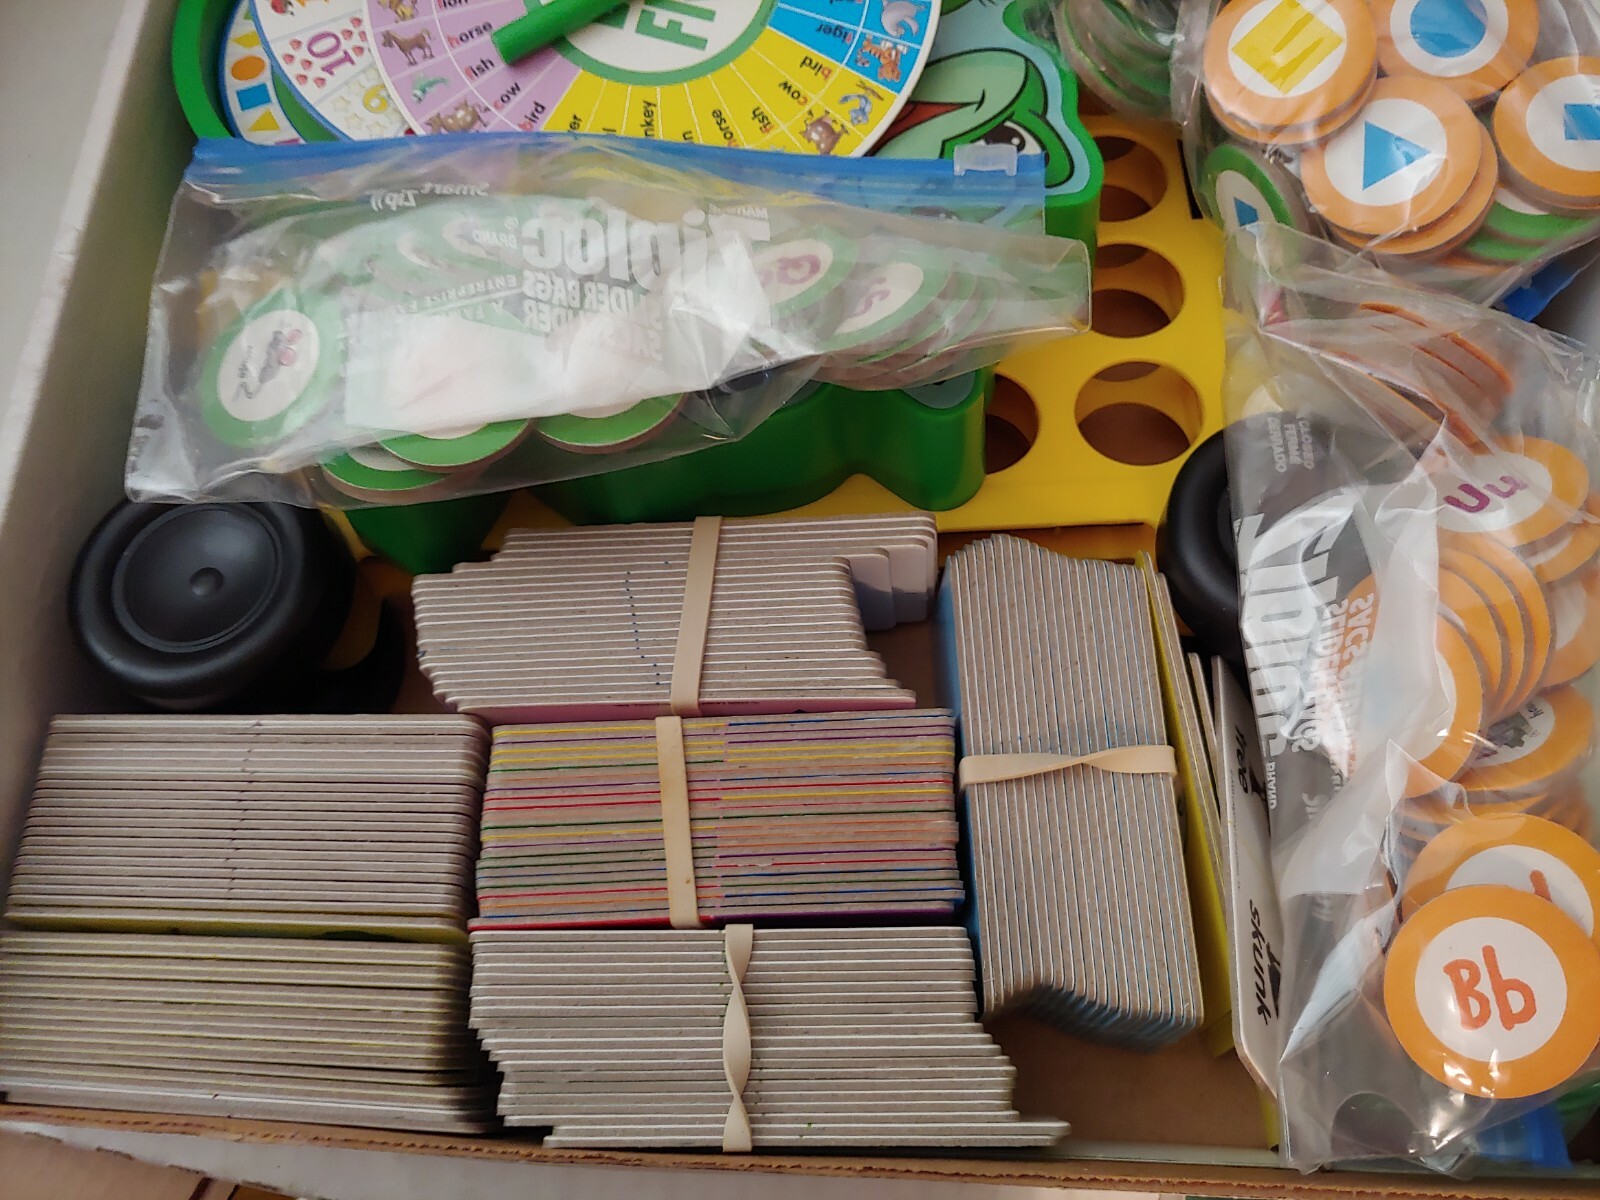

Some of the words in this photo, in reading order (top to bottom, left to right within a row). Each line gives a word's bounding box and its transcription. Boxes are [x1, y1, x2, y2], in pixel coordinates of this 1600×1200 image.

[447, 21, 493, 48] horse
[816, 23, 854, 46] tiger
[307, 31, 356, 77] 10
[464, 57, 496, 80] fish
[800, 55, 833, 81] bird
[493, 82, 521, 109] cow
[778, 80, 809, 107] cow
[518, 101, 546, 131] bird
[751, 106, 775, 135] fish
[1249, 899, 1272, 1026] skunk
[1443, 944, 1537, 1032] Bb
